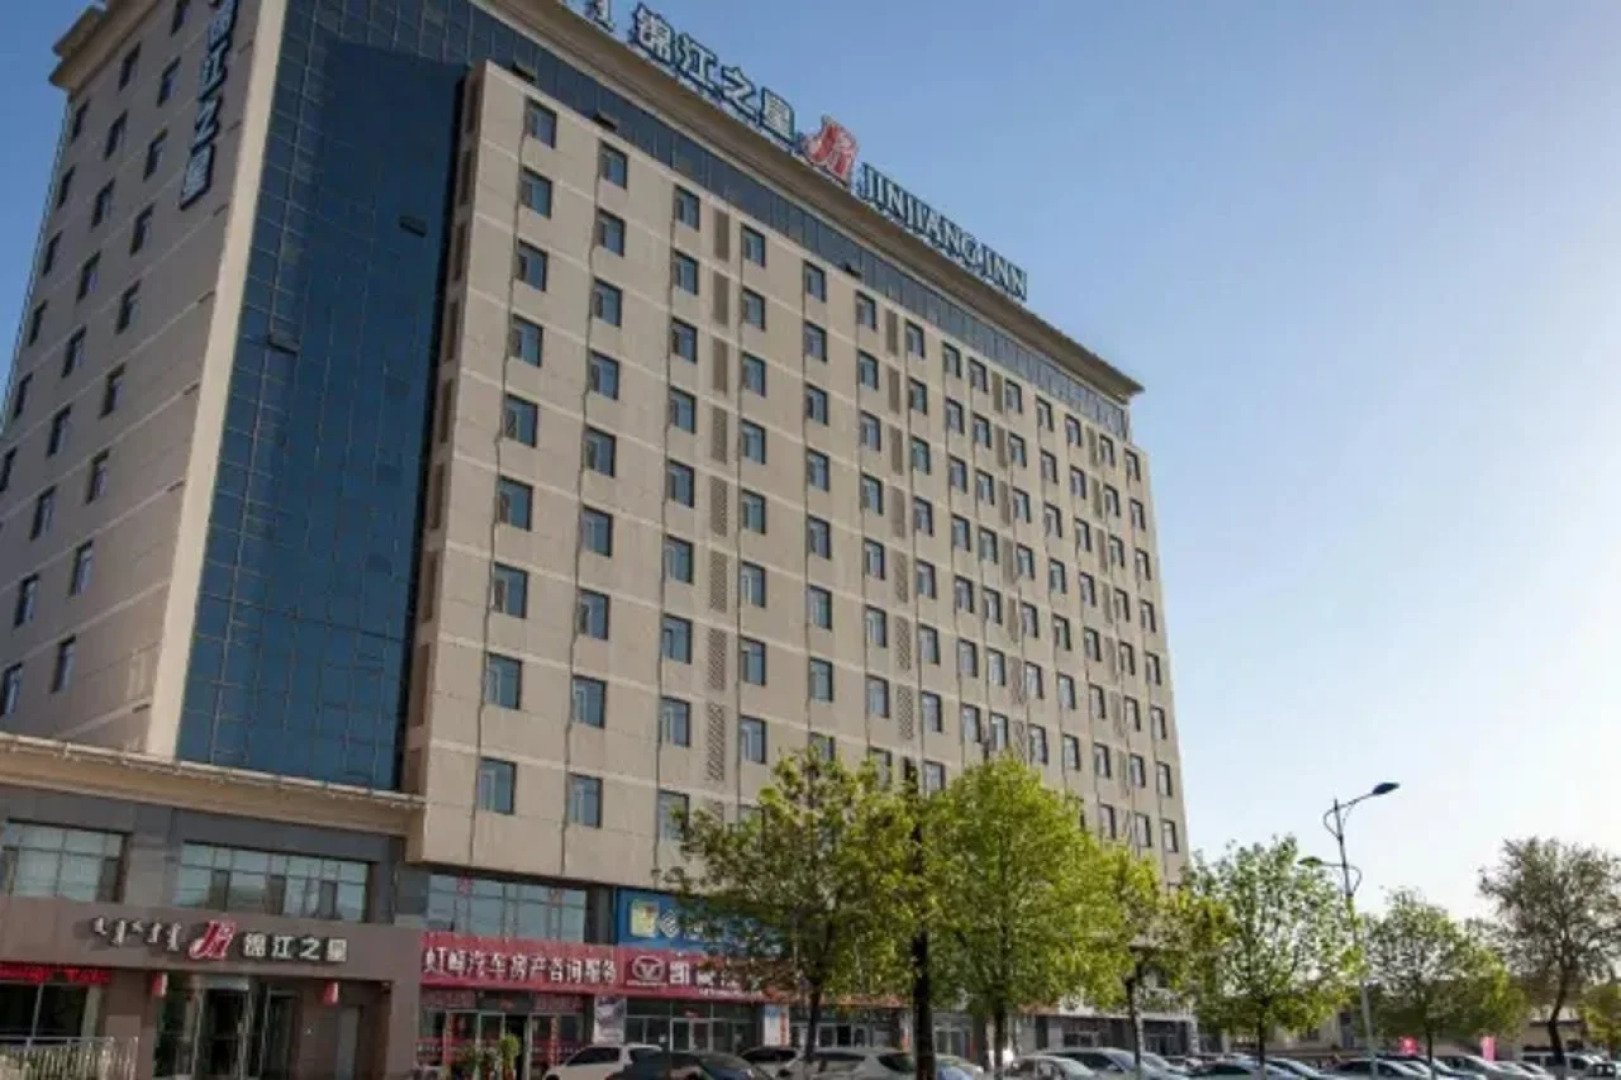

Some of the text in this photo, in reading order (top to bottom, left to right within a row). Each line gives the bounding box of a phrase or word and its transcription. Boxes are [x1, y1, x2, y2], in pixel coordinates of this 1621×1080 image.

[630, 2, 795, 146] 锦江之星
[857, 162, 1028, 301] JINJIANG INN
[244, 932, 348, 962] 锦江之星
